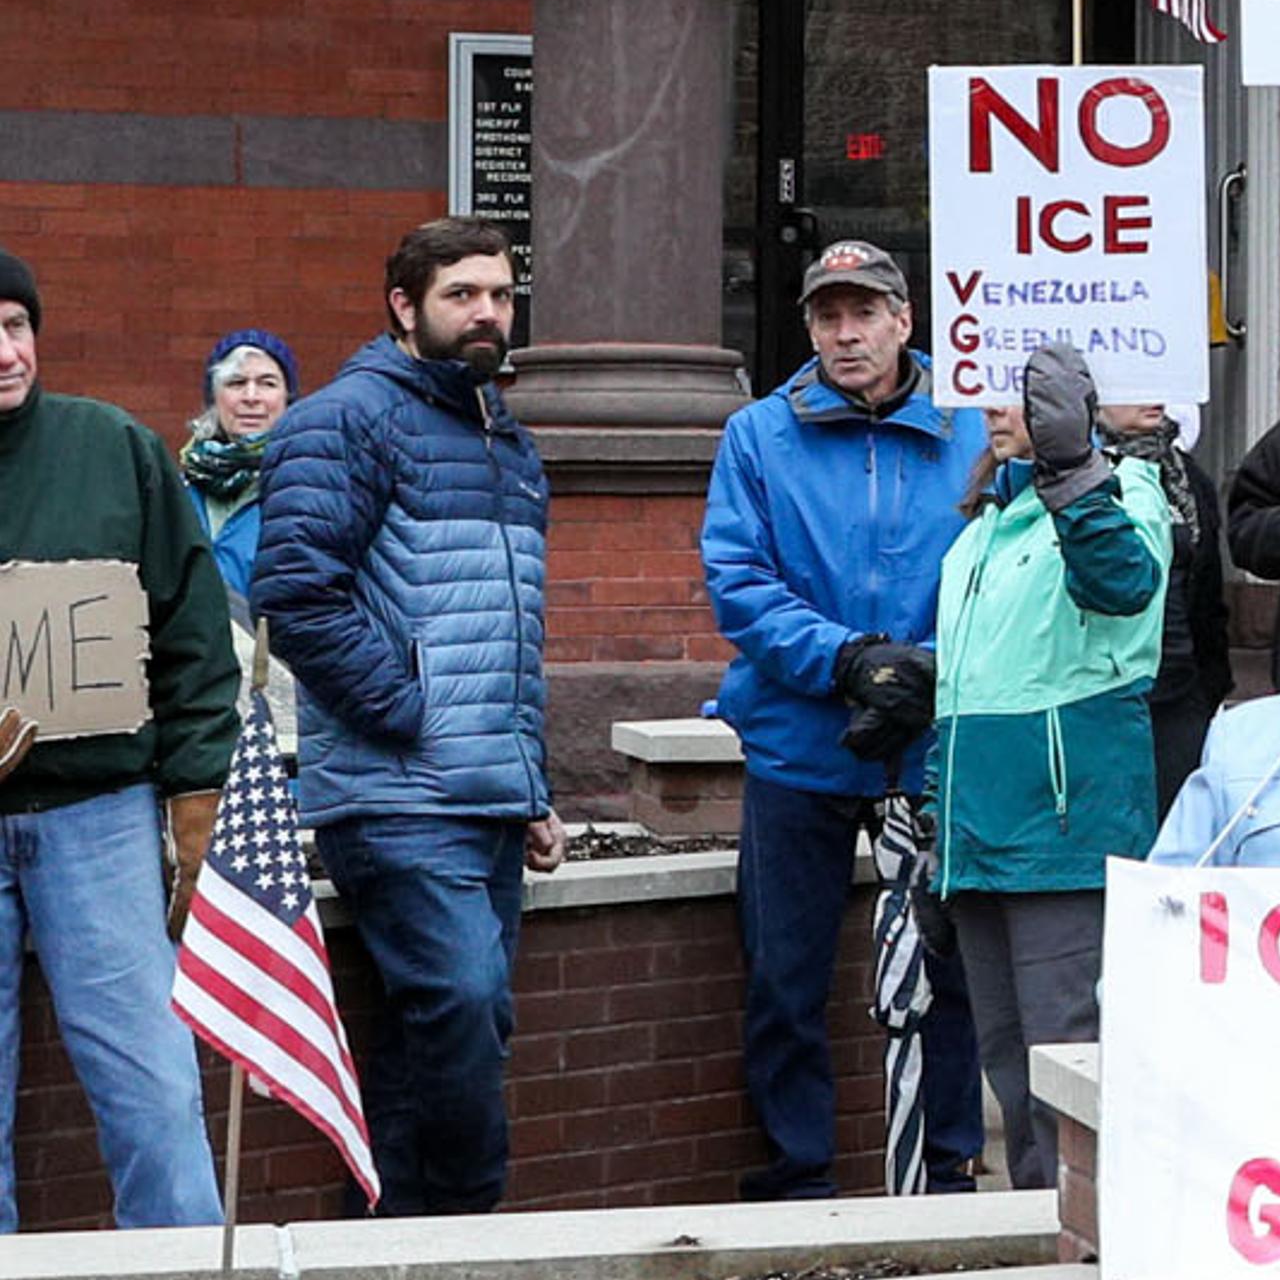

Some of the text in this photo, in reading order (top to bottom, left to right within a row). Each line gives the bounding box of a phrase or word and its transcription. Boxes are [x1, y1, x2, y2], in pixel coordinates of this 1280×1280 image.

[968, 77, 1171, 174] NO
[475, 146, 522, 158] DISTRICT
[475, 160, 526, 170] REGISTER
[1016, 195, 1152, 254] ICE
[946, 269, 1150, 306] VENEZUELA
[949, 313, 1168, 358] GREENLAND
[952, 359, 1027, 397] CUB
